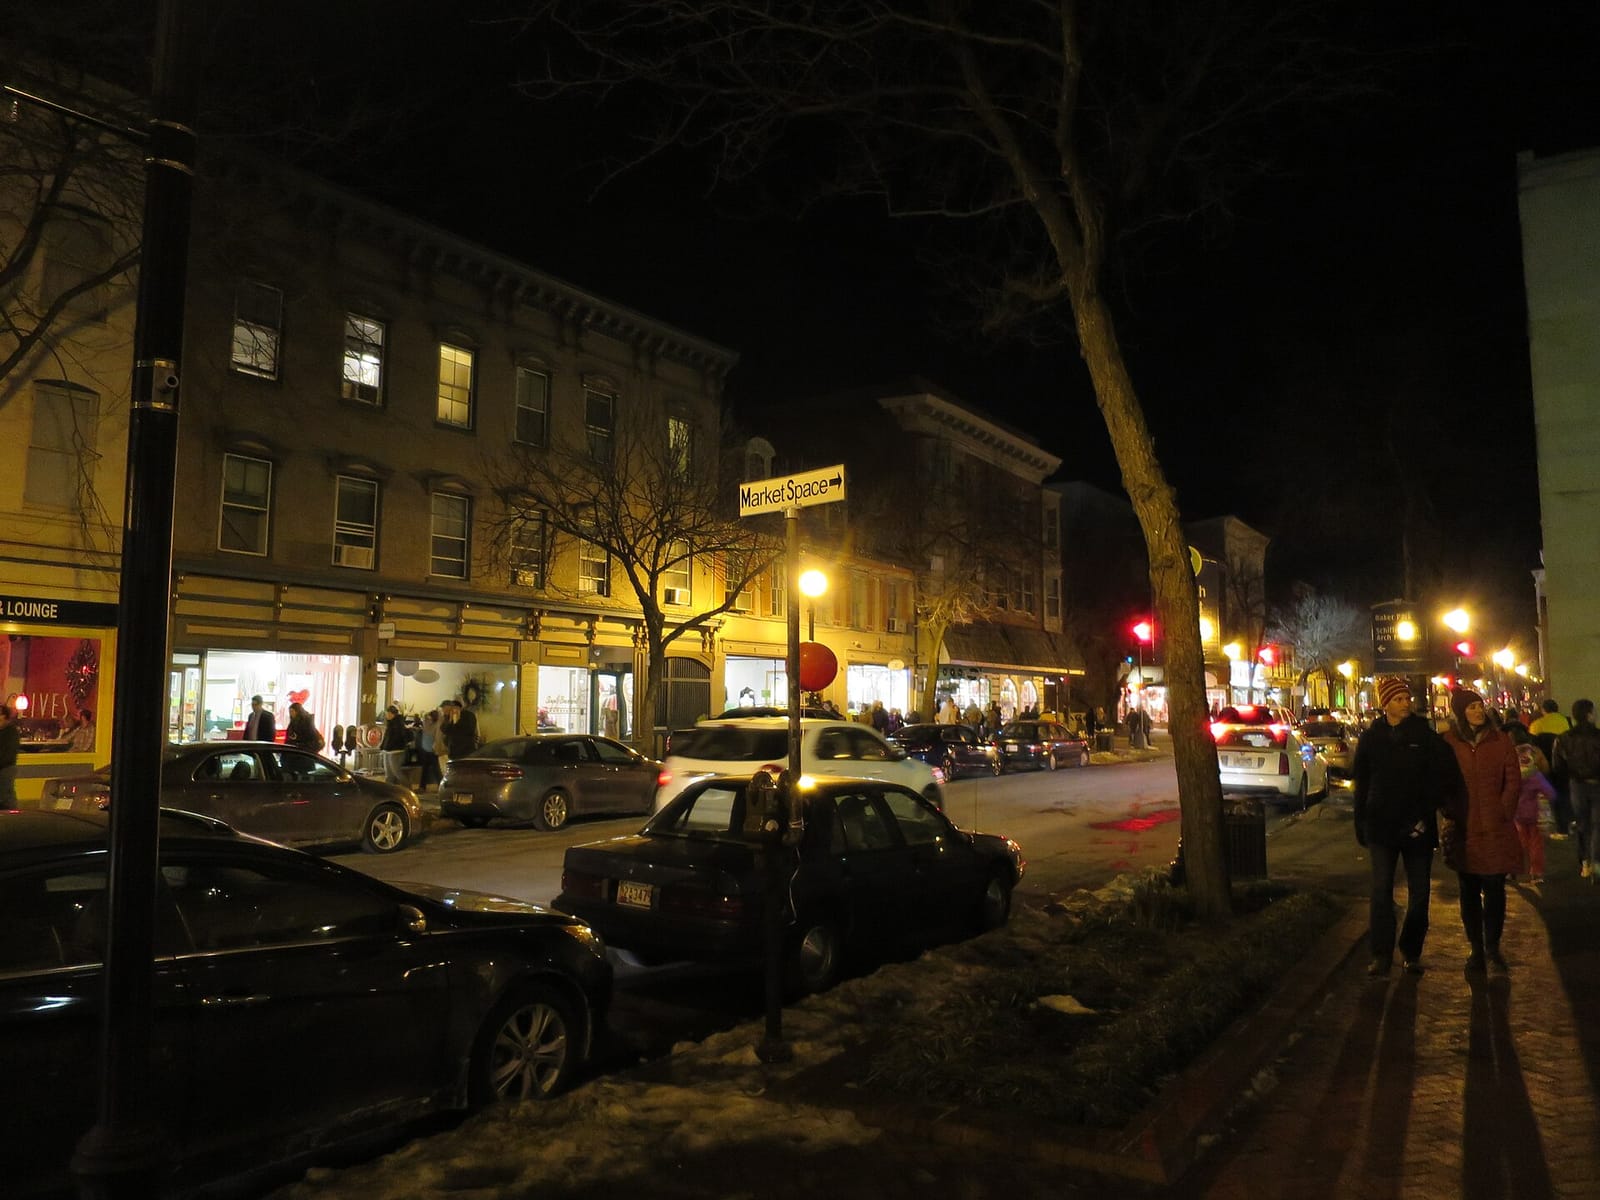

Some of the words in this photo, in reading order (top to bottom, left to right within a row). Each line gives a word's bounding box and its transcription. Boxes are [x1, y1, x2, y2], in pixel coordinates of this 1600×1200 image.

[741, 484, 785, 509] Market
[786, 479, 828, 505] Space
[7, 600, 59, 619] LOUNGE
[7, 692, 69, 719] IVES
